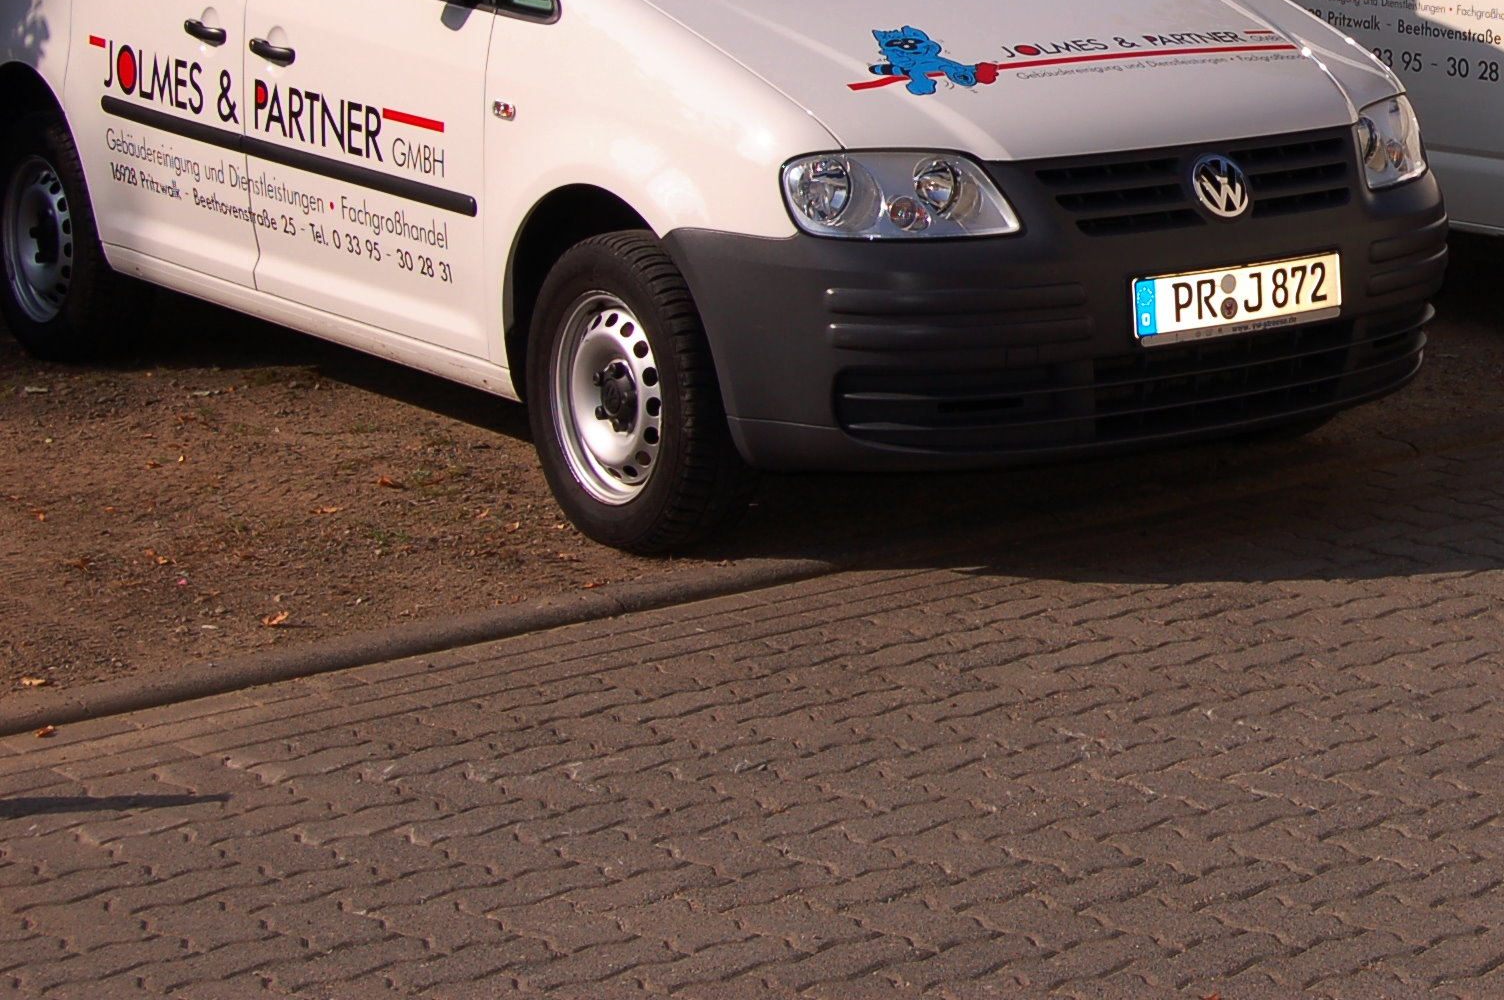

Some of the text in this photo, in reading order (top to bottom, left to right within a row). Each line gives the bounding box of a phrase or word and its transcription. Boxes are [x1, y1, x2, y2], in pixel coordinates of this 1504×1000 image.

[1001, 38, 1109, 59] JOLMES
[1113, 36, 1139, 49] &
[1142, 31, 1248, 47] PARTNER
[1327, 10, 1380, 31] Pritzwalk
[1397, 18, 1502, 46] Beethovenstraße
[1401, 50, 1423, 73] 95
[1446, 56, 1469, 79] 30
[1478, 60, 1500, 83] 28
[104, 40, 445, 178] JOLMES & PARTNER GMBH
[106, 127, 449, 250] Gebäudereinigung und Dienstleistungen Fachgroßhandel
[193, 187, 278, 231] Beethovenstraße
[281, 215, 297, 236] 25
[309, 222, 329, 247] Tel.
[332, 229, 342, 250] 0
[345, 234, 362, 257] 33
[365, 240, 382, 262] 95
[396, 249, 414, 272] 30
[418, 256, 435, 278] 28
[439, 261, 453, 284] 31
[1172, 278, 1218, 323] PR
[1272, 261, 1328, 309] 872
